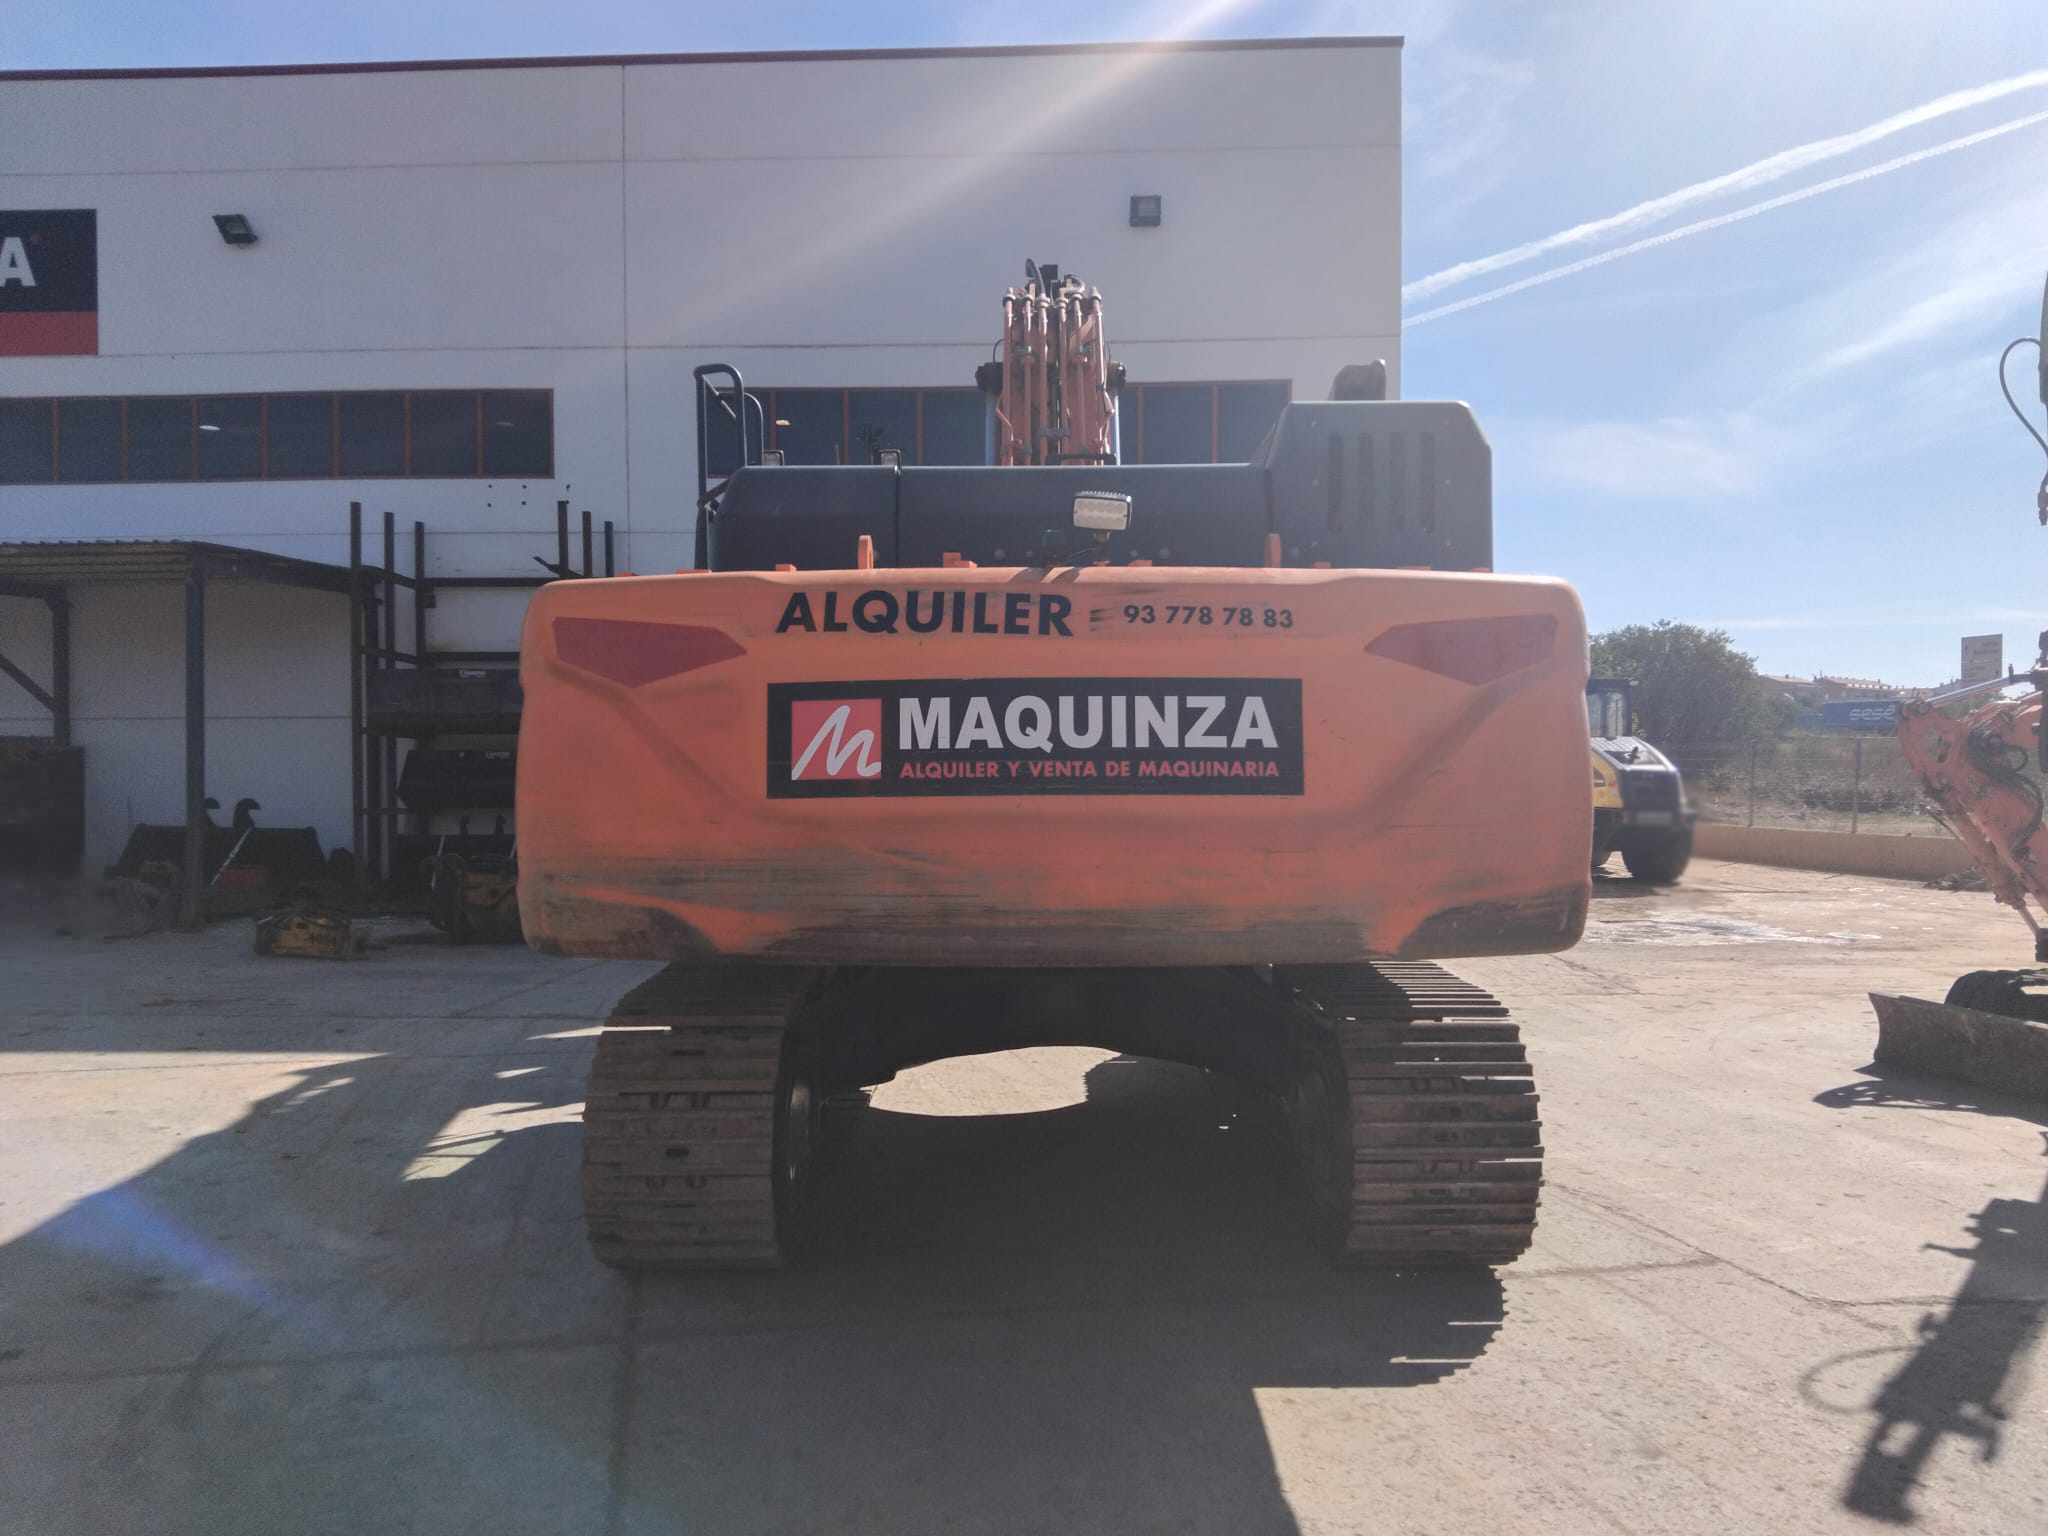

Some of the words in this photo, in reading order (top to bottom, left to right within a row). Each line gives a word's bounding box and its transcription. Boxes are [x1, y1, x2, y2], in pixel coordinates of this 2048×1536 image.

[775, 589, 1074, 637] ALQUILER
[1123, 604, 1156, 624] 93
[1165, 605, 1213, 625] 778
[1222, 607, 1254, 627] 78
[1263, 608, 1294, 629] 83
[899, 694, 1279, 753] MAQUINZA
[899, 760, 1000, 780] ALQUILER
[1007, 760, 1021, 777] Y
[1028, 760, 1098, 778] VENTA
[1105, 760, 1131, 777] DE
[1138, 760, 1280, 778] MAQUINARIA
